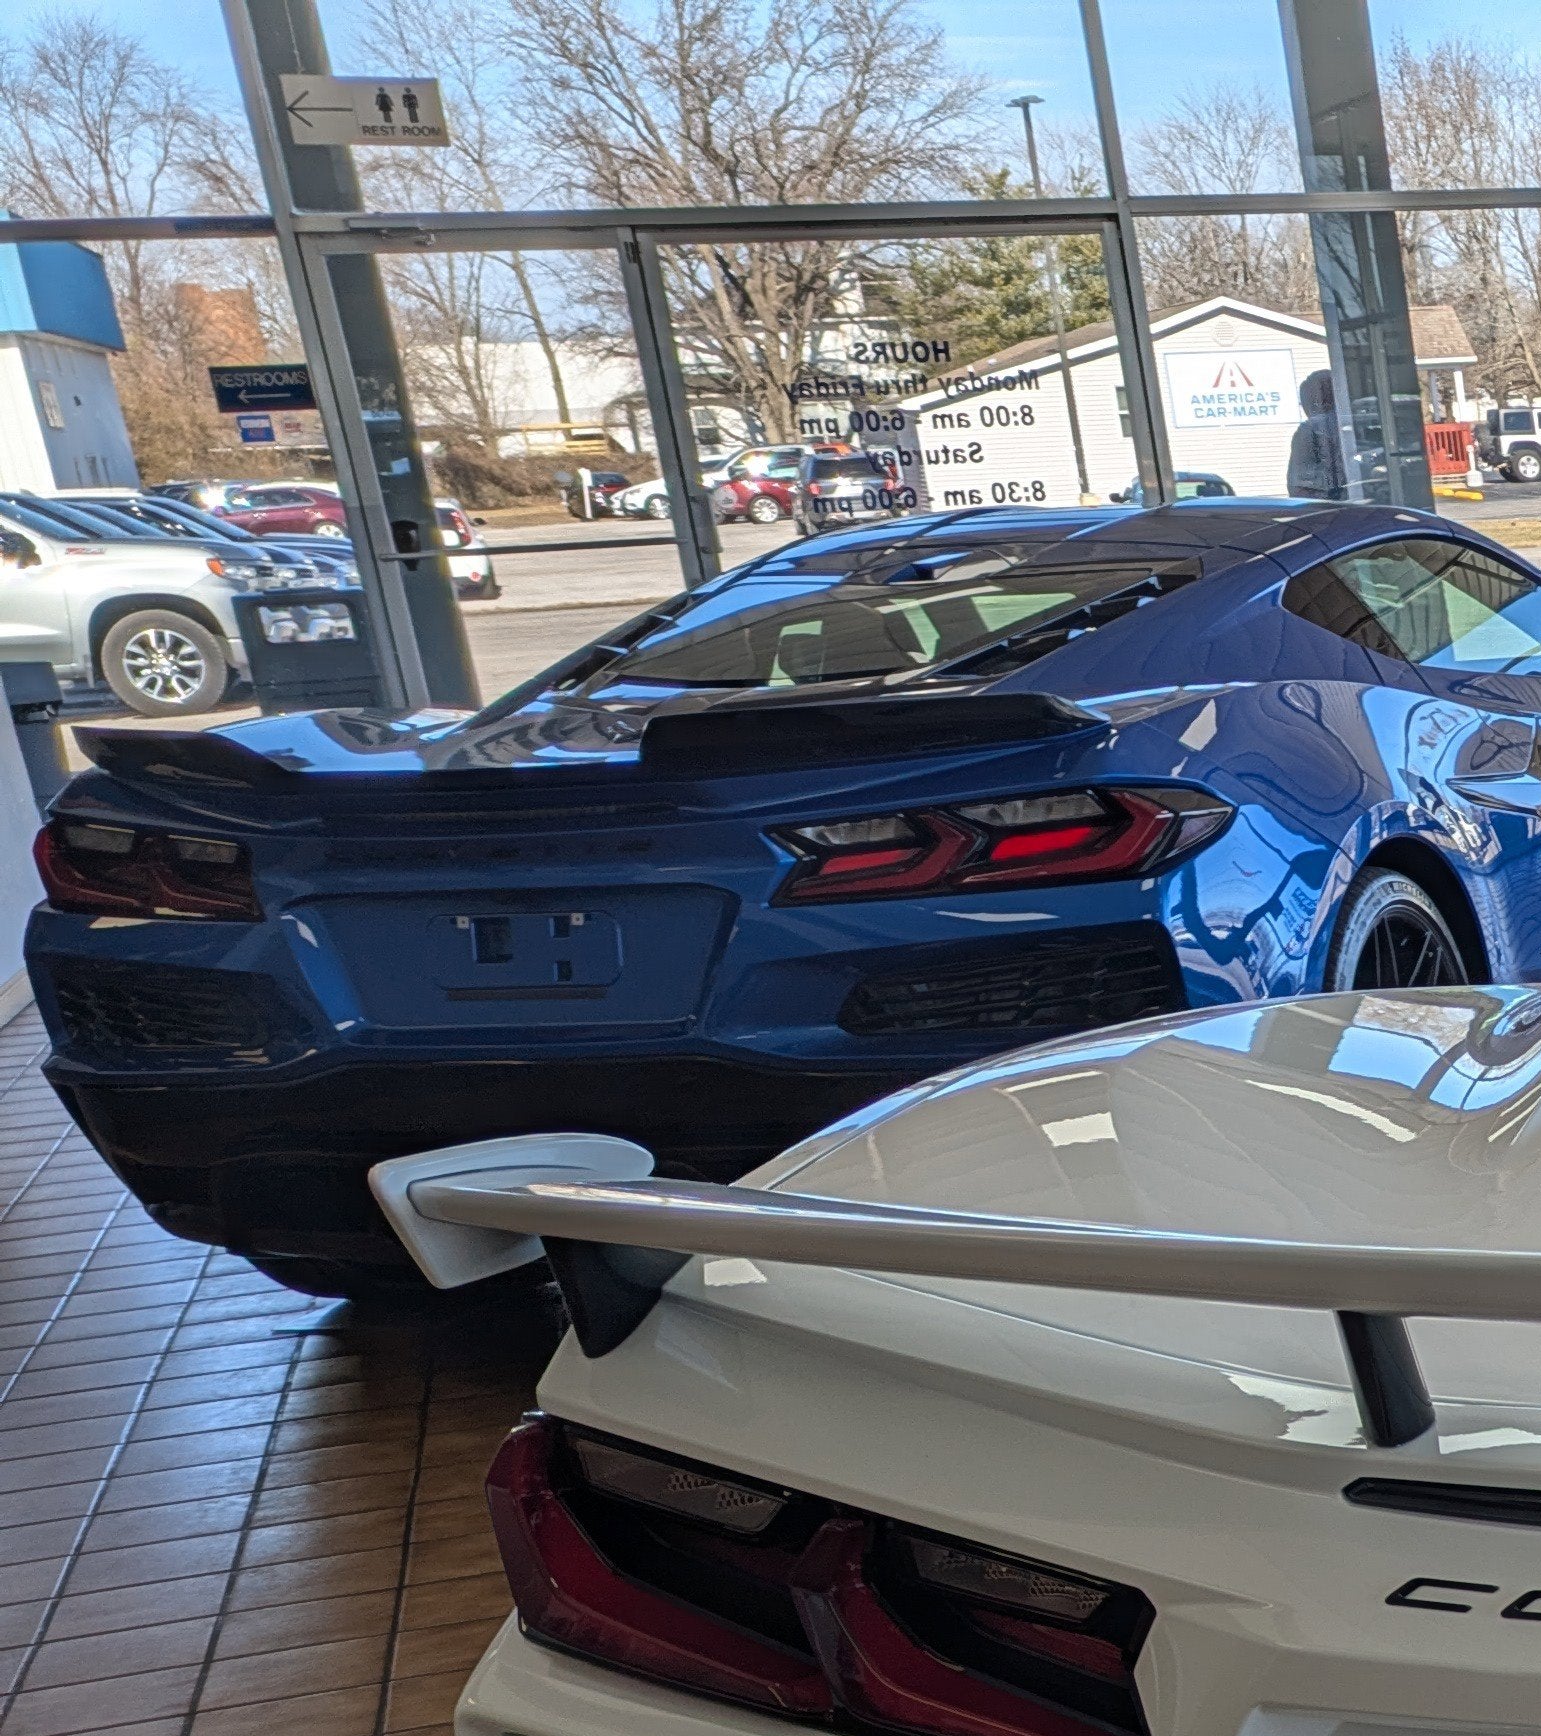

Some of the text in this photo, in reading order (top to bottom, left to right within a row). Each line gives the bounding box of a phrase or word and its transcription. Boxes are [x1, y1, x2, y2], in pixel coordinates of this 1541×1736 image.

[362, 125, 440, 137] REST ROOM
[212, 371, 308, 388] RESTROOMS
[1190, 391, 1281, 405] AMERICA'S
[1194, 405, 1279, 419] CAR-MART
